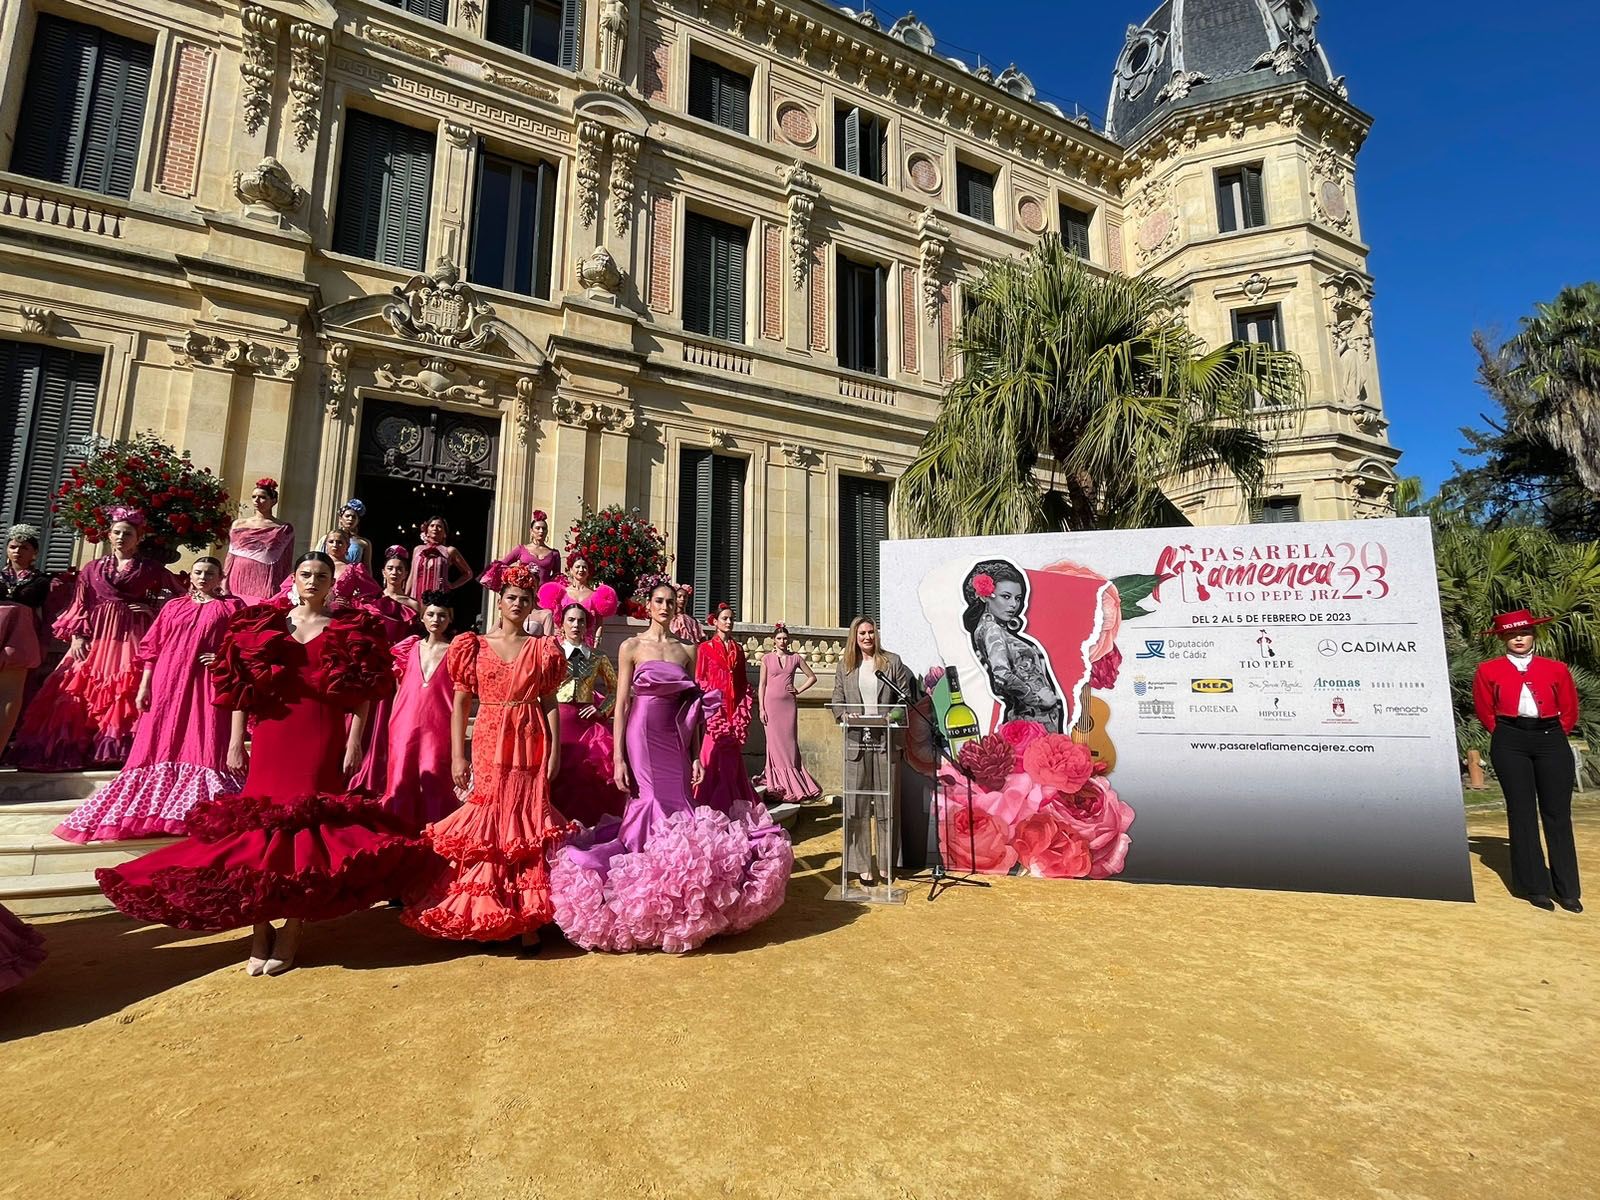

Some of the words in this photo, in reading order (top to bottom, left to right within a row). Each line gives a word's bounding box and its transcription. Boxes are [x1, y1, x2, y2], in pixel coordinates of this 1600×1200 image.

[1202, 544, 1335, 562] PASARELA
[1226, 591, 1256, 602] TIO
[1262, 590, 1304, 602] PEPE
[1310, 589, 1341, 601] JRZ
[1192, 615, 1210, 624] DEL
[1212, 615, 1219, 624] 2
[1221, 615, 1234, 624] AL
[1236, 615, 1243, 623] 5
[1245, 614, 1259, 623] DE
[1262, 613, 1307, 623] FEBRERO
[1309, 613, 1323, 622] DE
[1325, 612, 1352, 622] 2023
[1168, 639, 1215, 649] Diputación
[1341, 641, 1417, 653] CADIMAR
[1169, 650, 1180, 659] de
[1183, 650, 1207, 659] Cádiz
[1240, 660, 1261, 669] TIO
[1264, 660, 1295, 669] PEPE
[1313, 677, 1361, 688] Aromas
[1189, 704, 1239, 713] FLORENEA
[1385, 705, 1429, 713] menacho
[1258, 710, 1297, 718] HIPOTELS
[1190, 741, 1375, 753] www.pasarelaflamencajerez.com
